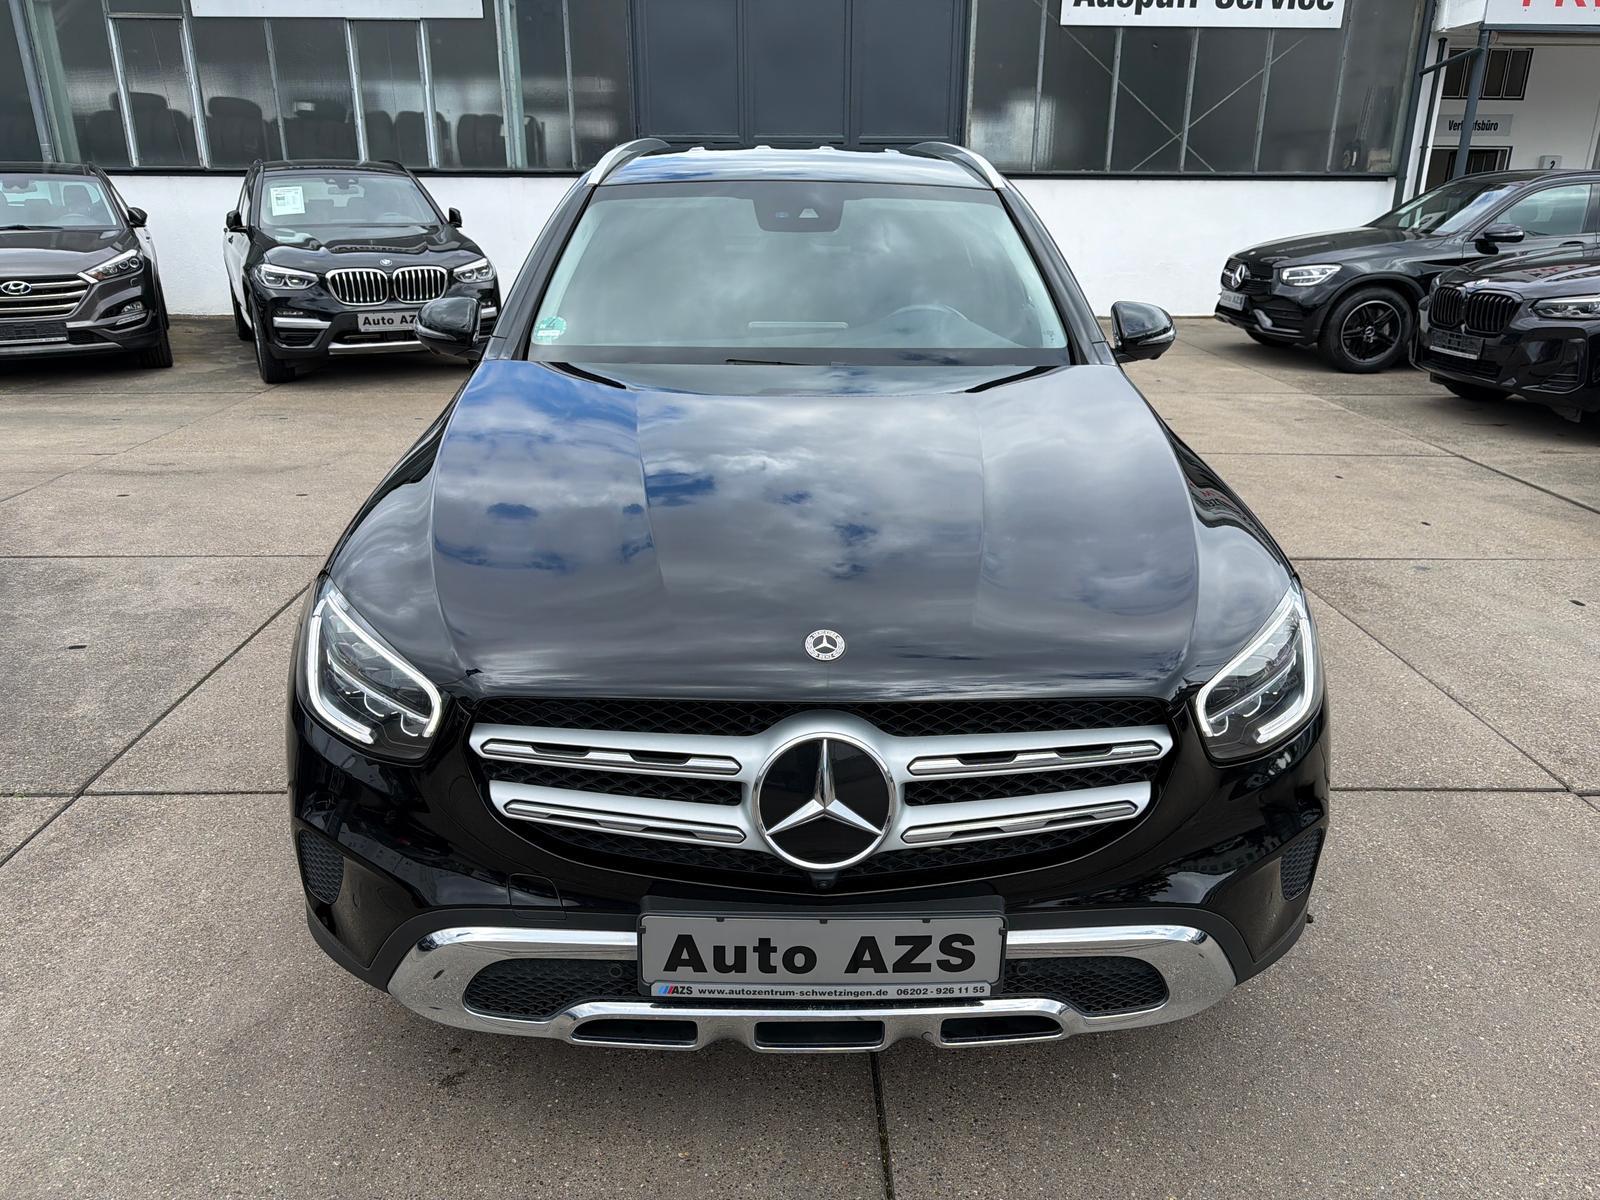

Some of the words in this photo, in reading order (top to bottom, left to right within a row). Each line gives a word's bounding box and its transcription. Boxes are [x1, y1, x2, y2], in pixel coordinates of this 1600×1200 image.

[1448, 119, 1499, 131] Verfsbüro
[363, 317, 394, 325] Auto
[401, 315, 416, 324] AZ
[662, 934, 818, 974] Auto
[844, 933, 977, 974] AZS
[671, 985, 694, 995] AZS
[698, 986, 889, 997] www.autozentrum-schwetzingen.de
[896, 987, 929, 996] 06202
[935, 987, 955, 995] 926
[957, 986, 970, 995] 11
[972, 985, 986, 994] 55
